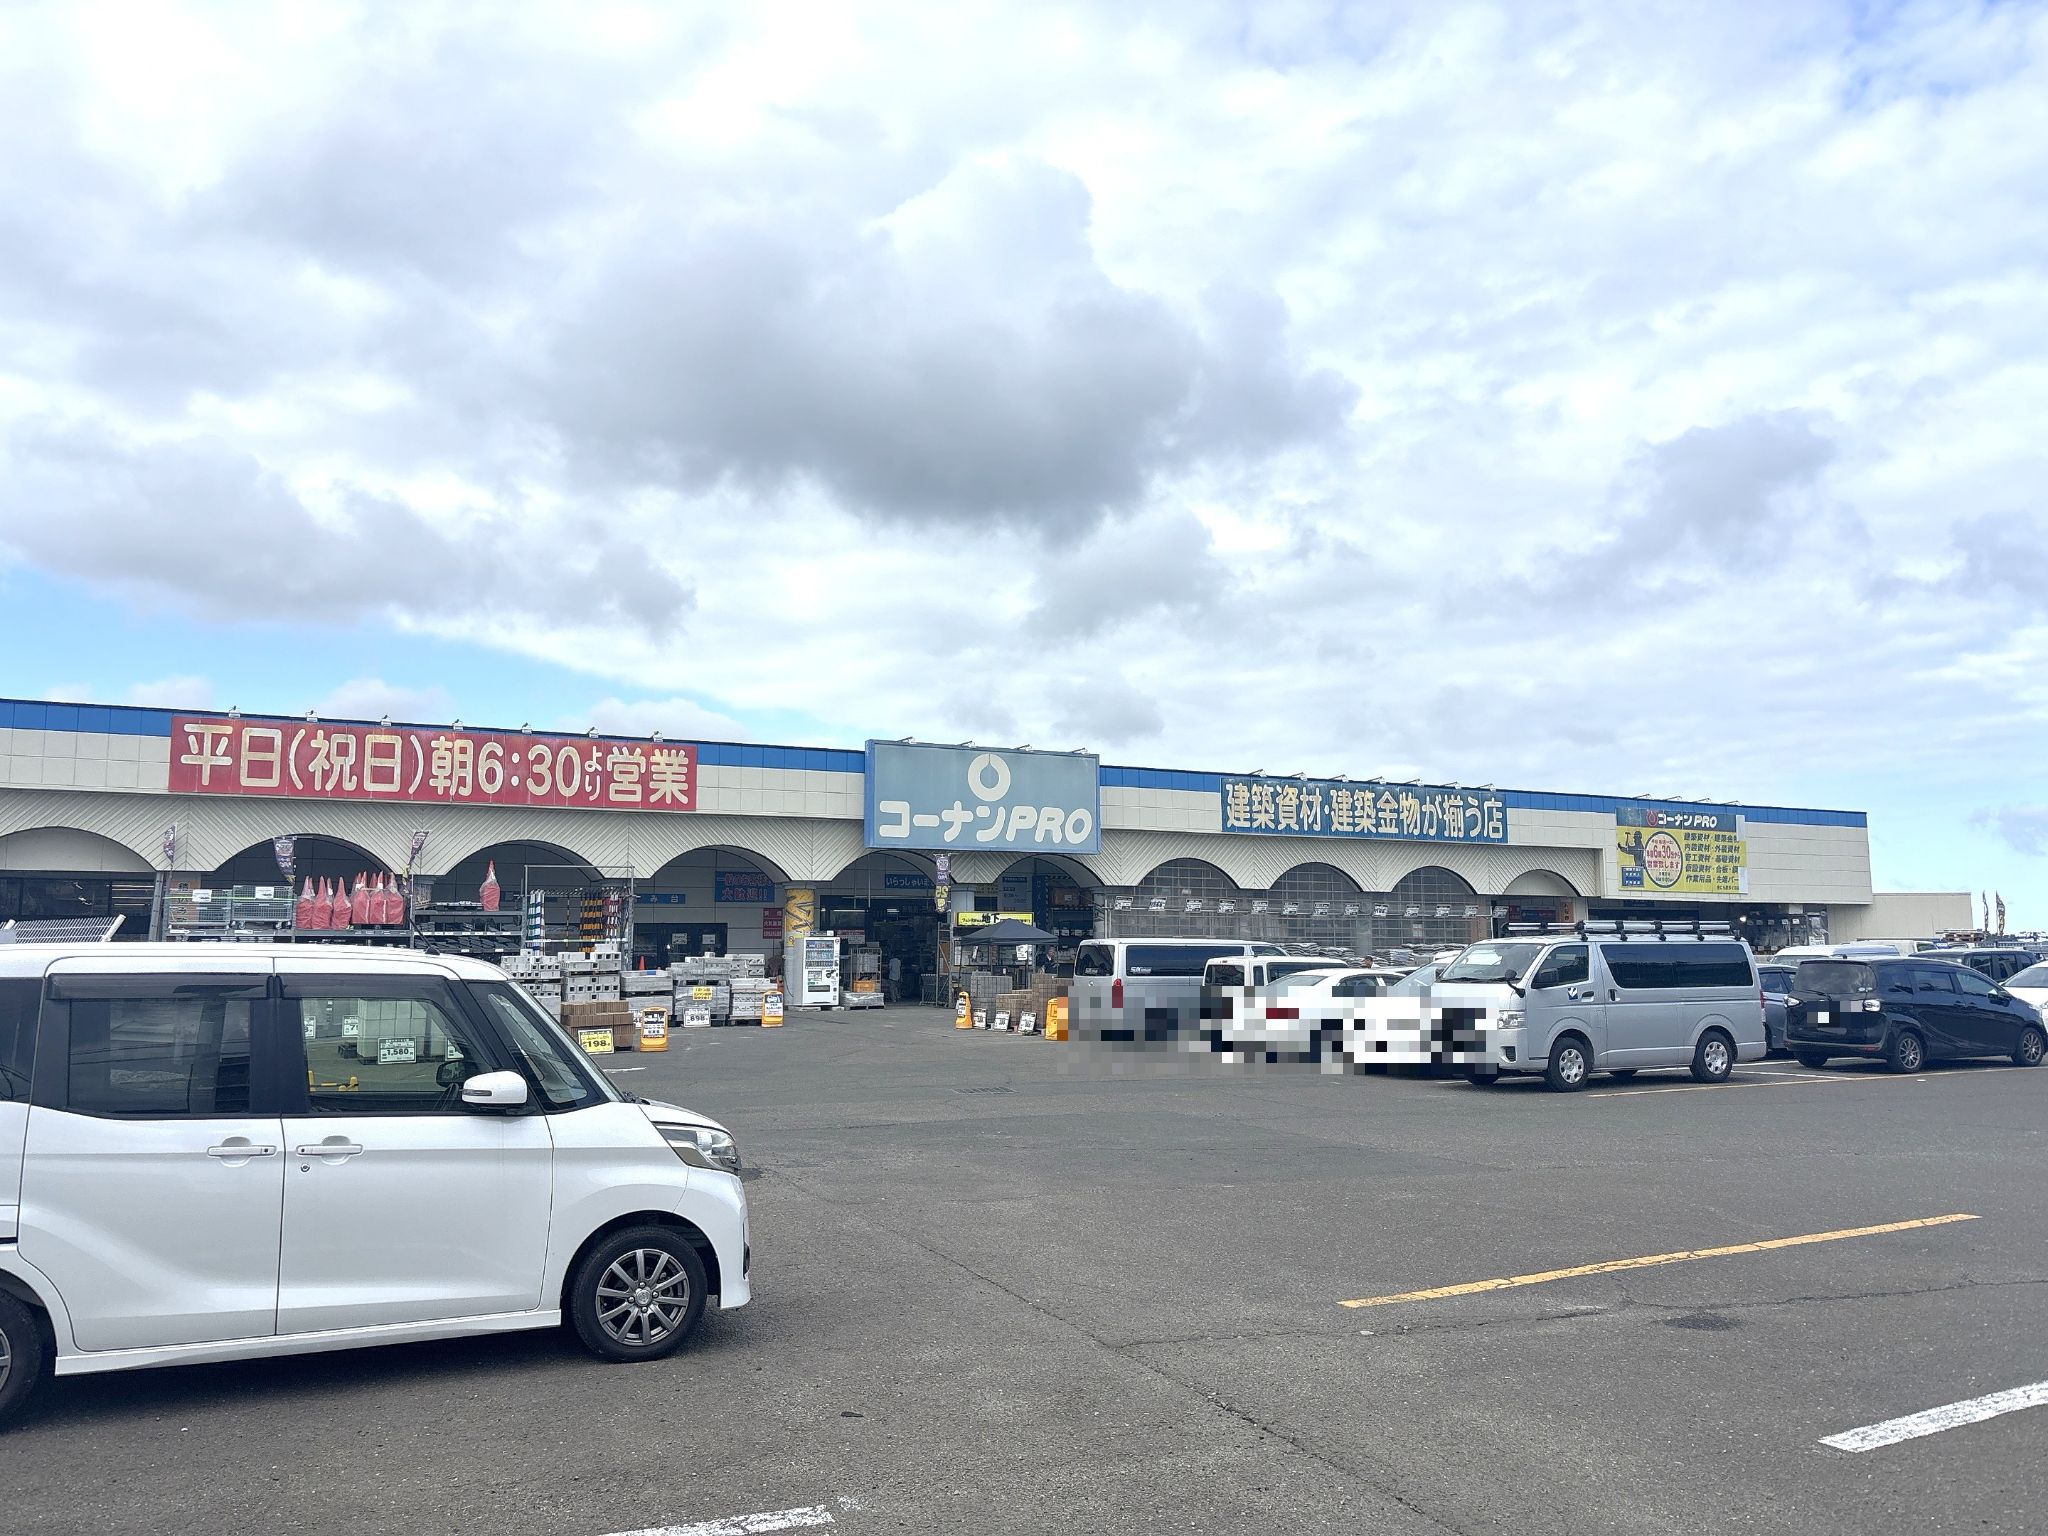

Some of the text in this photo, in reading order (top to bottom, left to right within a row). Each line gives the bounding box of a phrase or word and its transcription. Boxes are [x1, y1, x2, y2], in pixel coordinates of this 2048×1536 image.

[879, 800, 1093, 844] コーナンPRO
[1226, 783, 1502, 839] 建築資材・建築金物が揃う店
